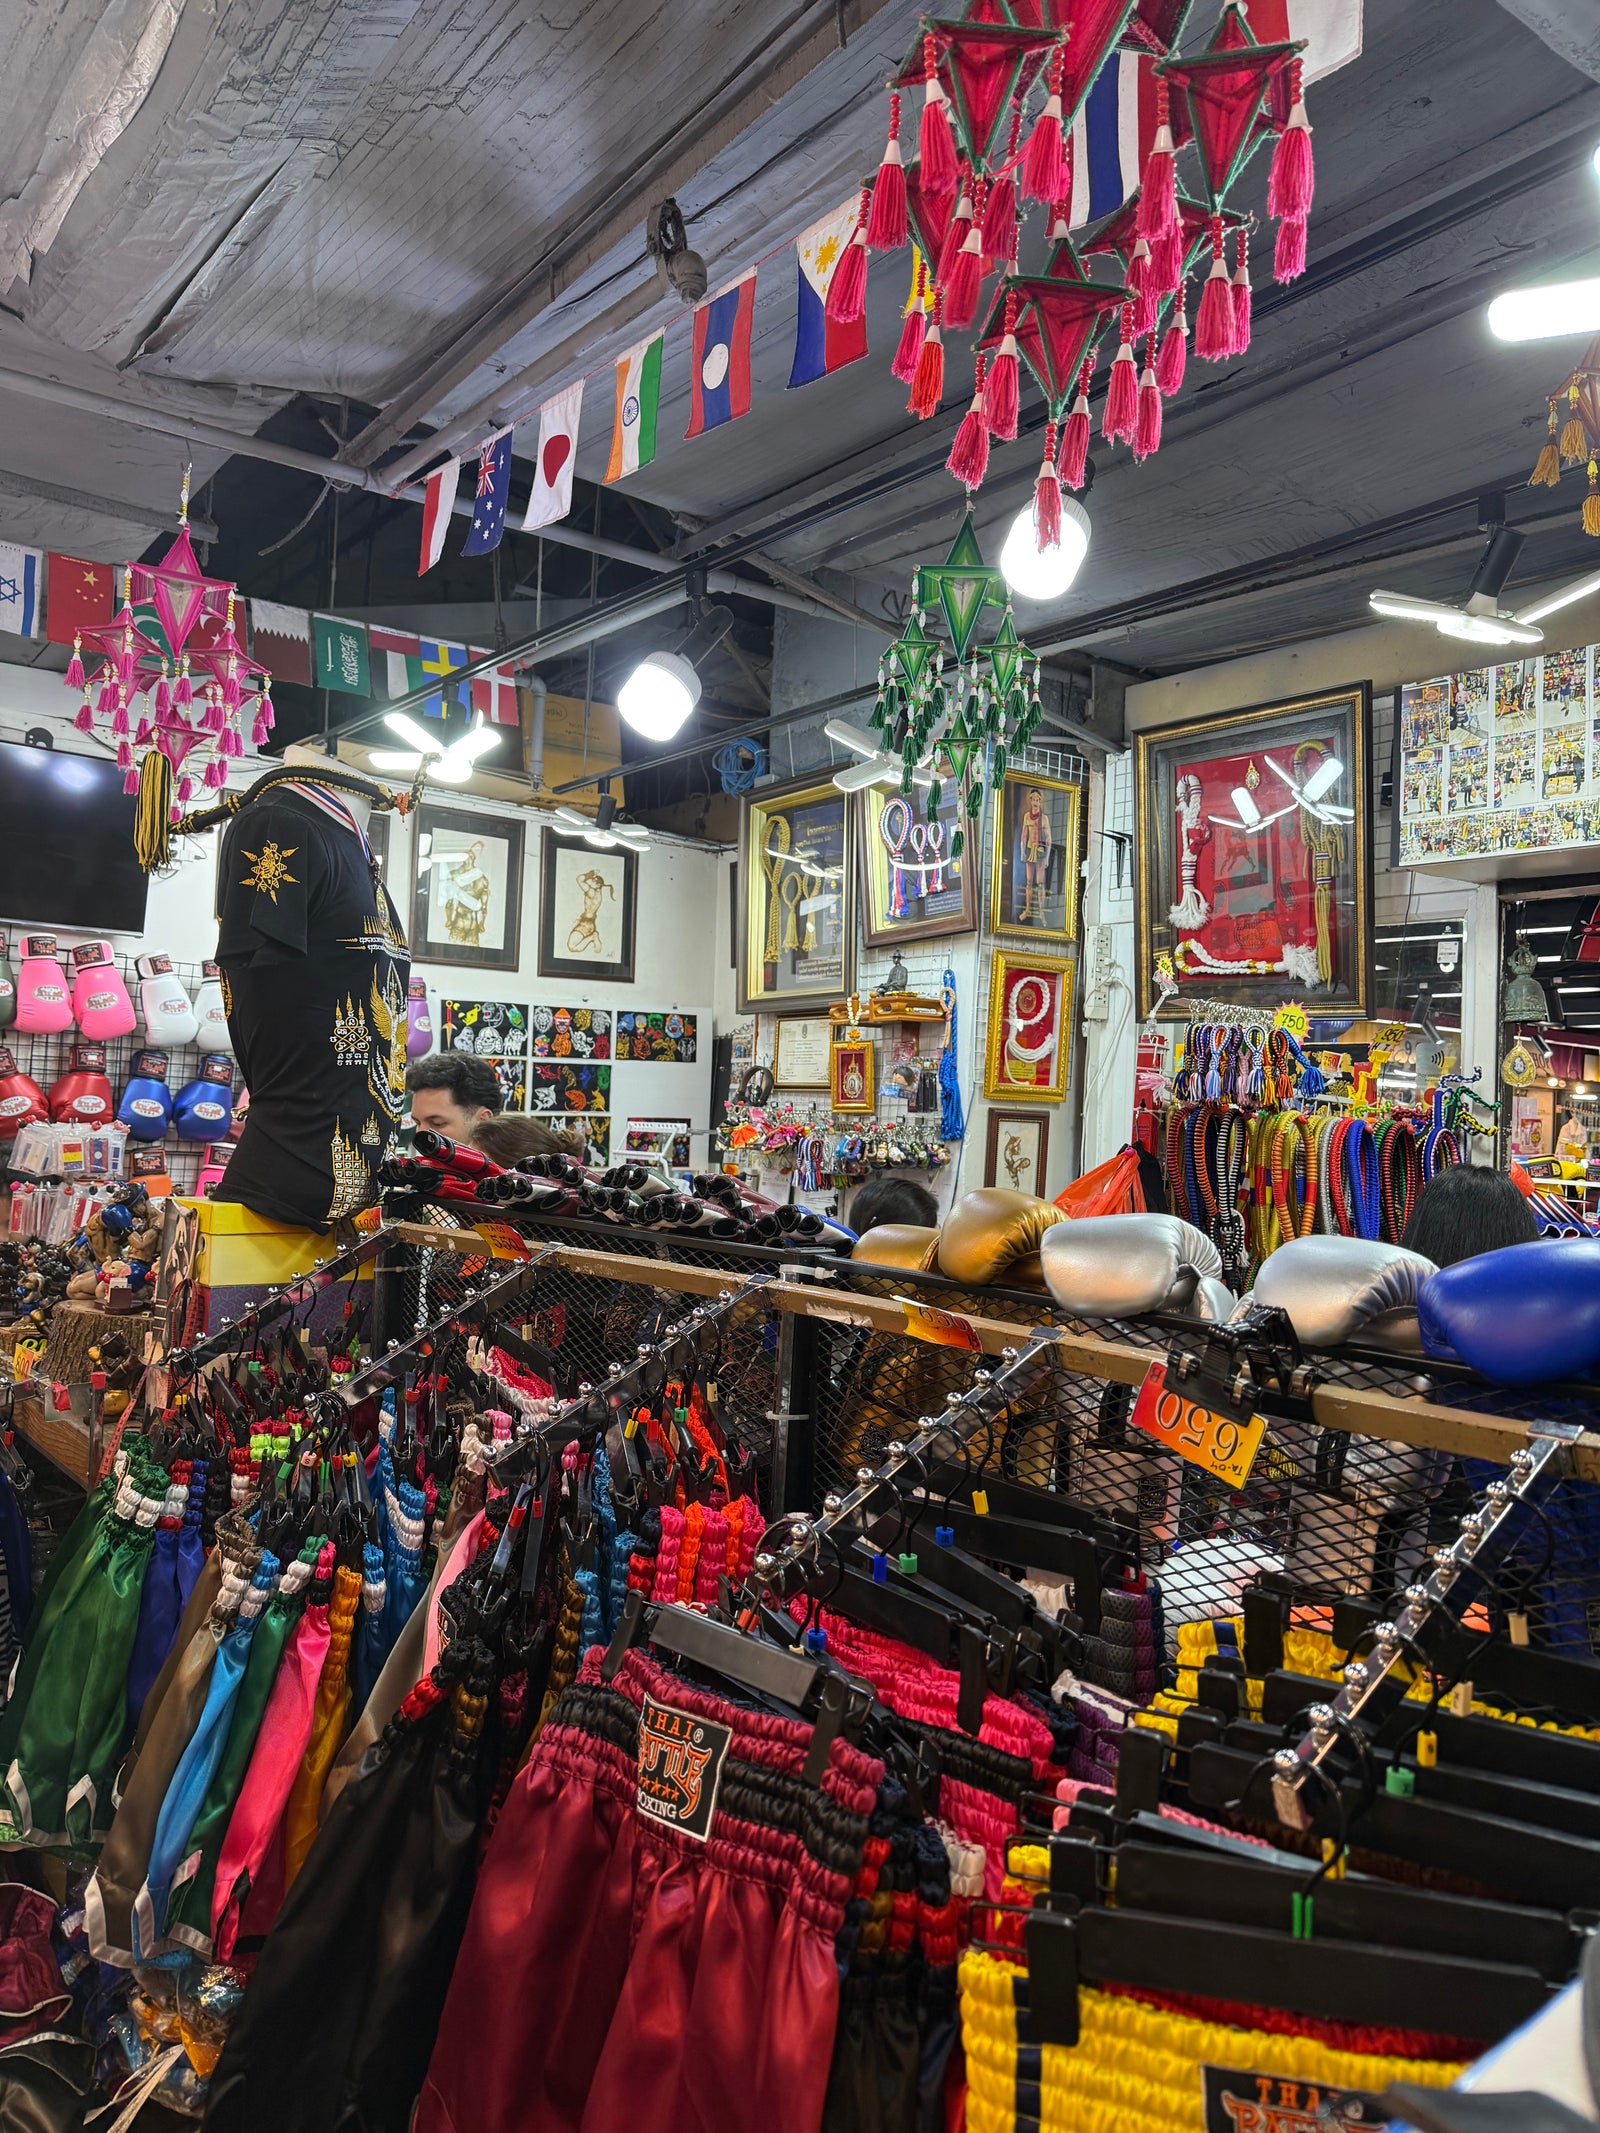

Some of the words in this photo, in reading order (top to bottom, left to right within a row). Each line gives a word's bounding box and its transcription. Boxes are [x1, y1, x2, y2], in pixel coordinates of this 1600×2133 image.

[1281, 1013, 1305, 1031] 750
[1324, 1055, 1337, 1069] 750
[490, 1233, 520, 1251] 550
[1155, 1390, 1240, 1462] 650
[646, 1707, 695, 1741] THAI
[637, 1788, 677, 1820] OXING
